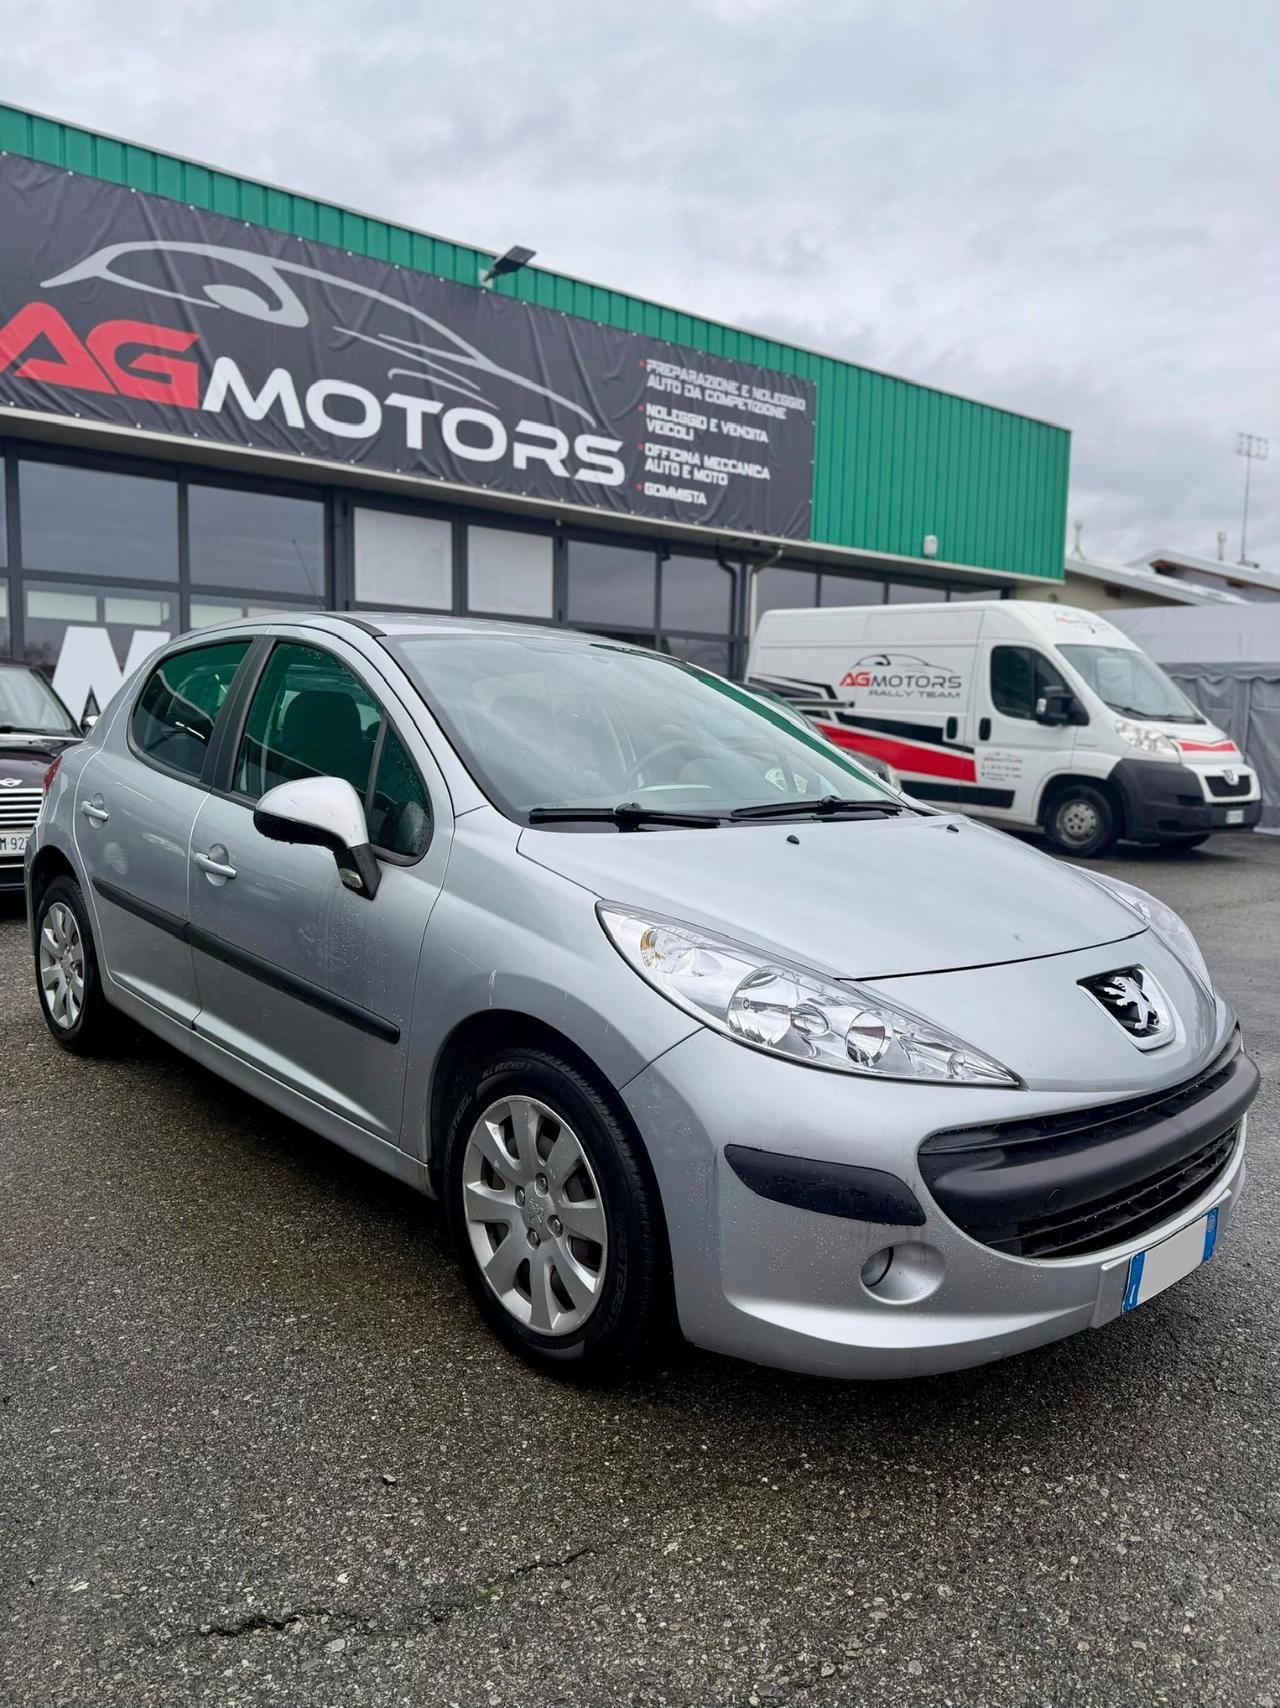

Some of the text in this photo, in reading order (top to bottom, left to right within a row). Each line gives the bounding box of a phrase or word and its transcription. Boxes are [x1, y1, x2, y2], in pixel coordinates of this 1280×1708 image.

[646, 359, 806, 411] PREPARAZIONE E NOLEGGIO
[647, 374, 787, 420] AUTO DA COMPETIZIONE
[646, 403, 769, 443] NOLEGGIO E VENDITA
[646, 417, 695, 441] VEICOLI
[645, 442, 770, 480] OFFICINA MECCANICA
[645, 457, 728, 486] AUTO E MOTO
[644, 482, 707, 505] GOMMISTA
[869, 689, 961, 699] RALLY TEAM
